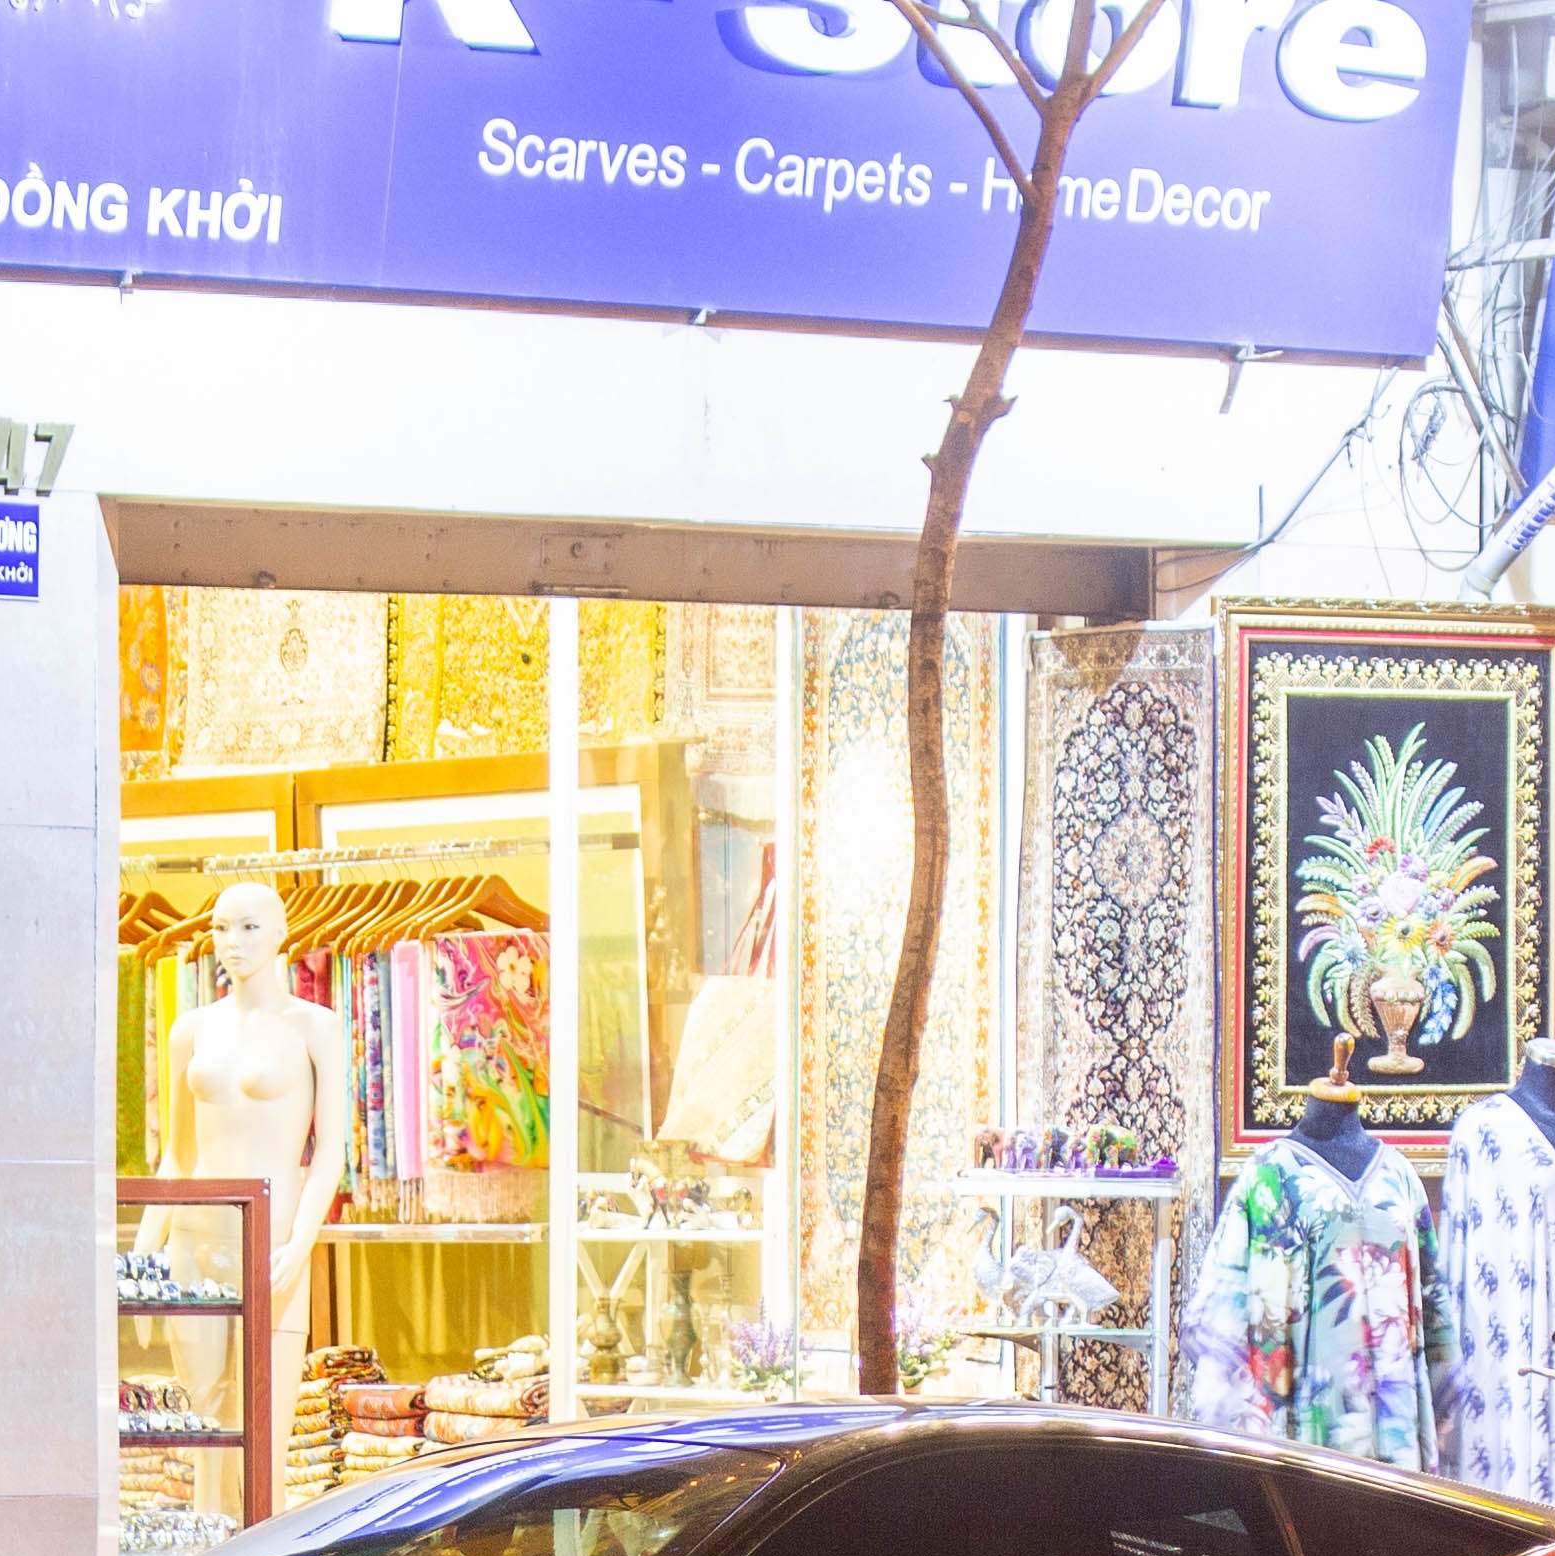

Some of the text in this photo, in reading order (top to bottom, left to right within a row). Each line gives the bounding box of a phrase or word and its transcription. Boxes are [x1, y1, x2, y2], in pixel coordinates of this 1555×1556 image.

[478, 118, 687, 188] Scarves
[734, 137, 933, 214] Carpets
[146, 178, 284, 245] KHỞI
